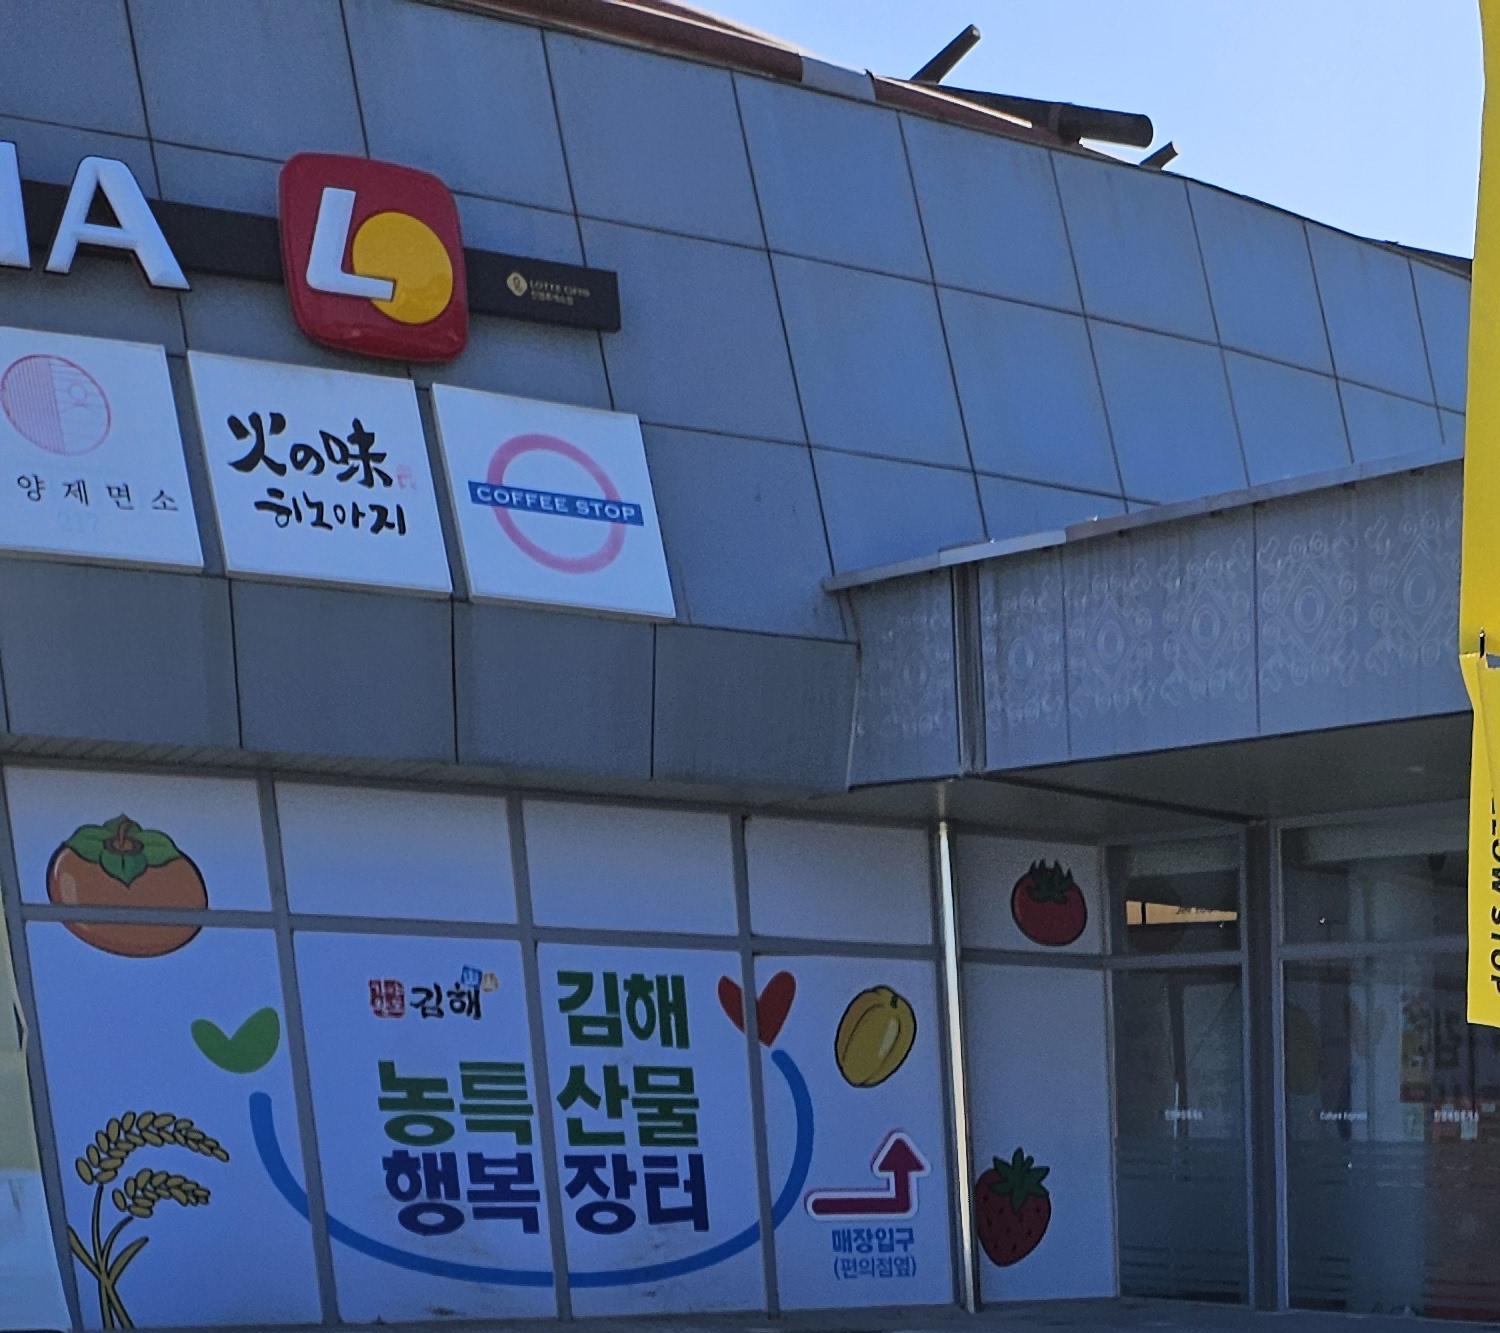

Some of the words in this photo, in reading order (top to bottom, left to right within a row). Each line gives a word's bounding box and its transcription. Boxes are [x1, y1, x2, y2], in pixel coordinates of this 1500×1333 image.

[228, 411, 393, 489] 火の味
[254, 487, 406, 536] 히노아지
[476, 486, 569, 513] COFFEE
[576, 499, 635, 521] STOP
[410, 981, 482, 1021] 김해
[557, 971, 690, 1049] 김해
[832, 1227, 914, 1254] 매장입구
